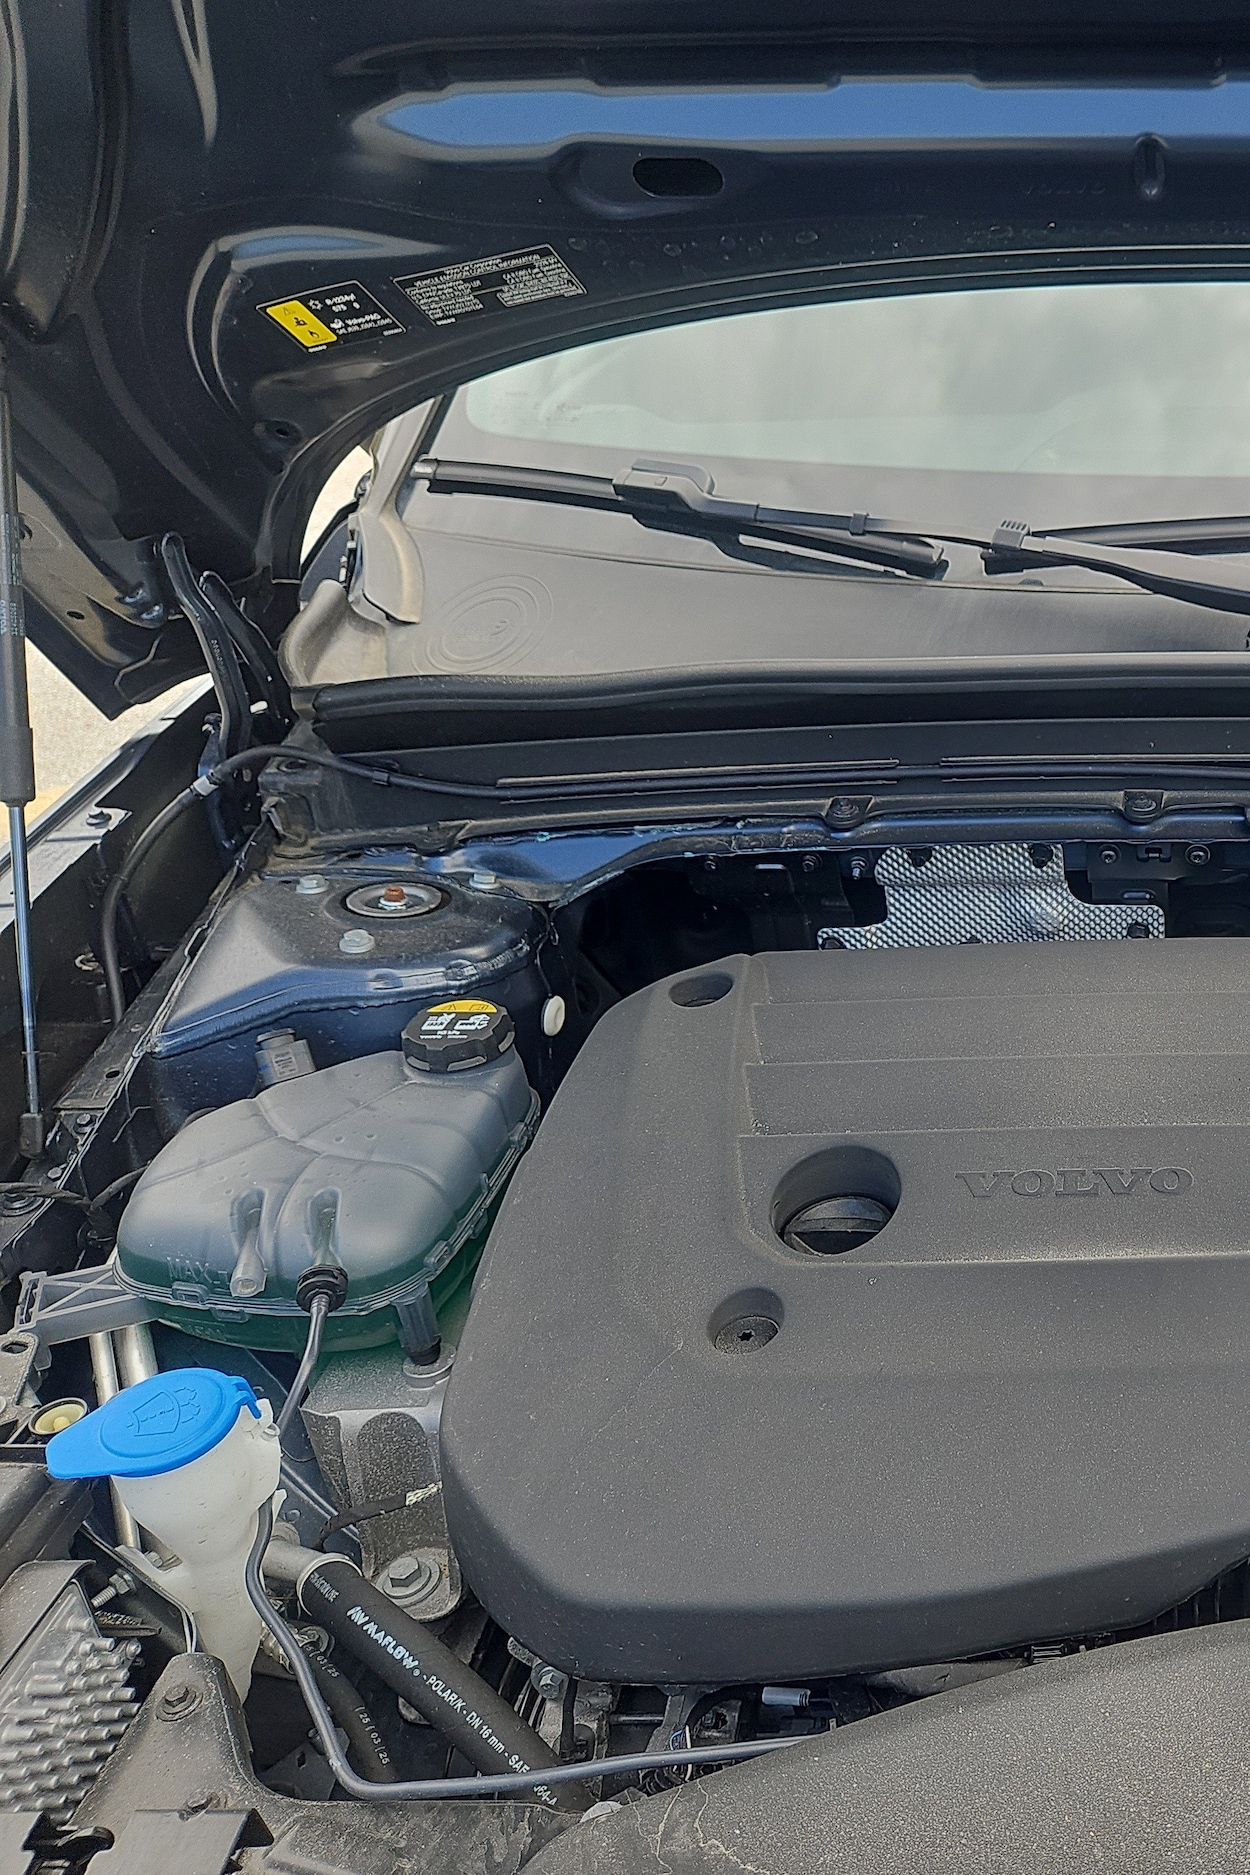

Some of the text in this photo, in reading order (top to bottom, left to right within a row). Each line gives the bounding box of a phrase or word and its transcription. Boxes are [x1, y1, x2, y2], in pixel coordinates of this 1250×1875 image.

[954, 1166, 1195, 1198] VOLVO
[425, 1674, 467, 1714] POLAR/K
[465, 1710, 483, 1730] DN
[479, 1724, 493, 1739] 16
[487, 1736, 506, 1754] mm
